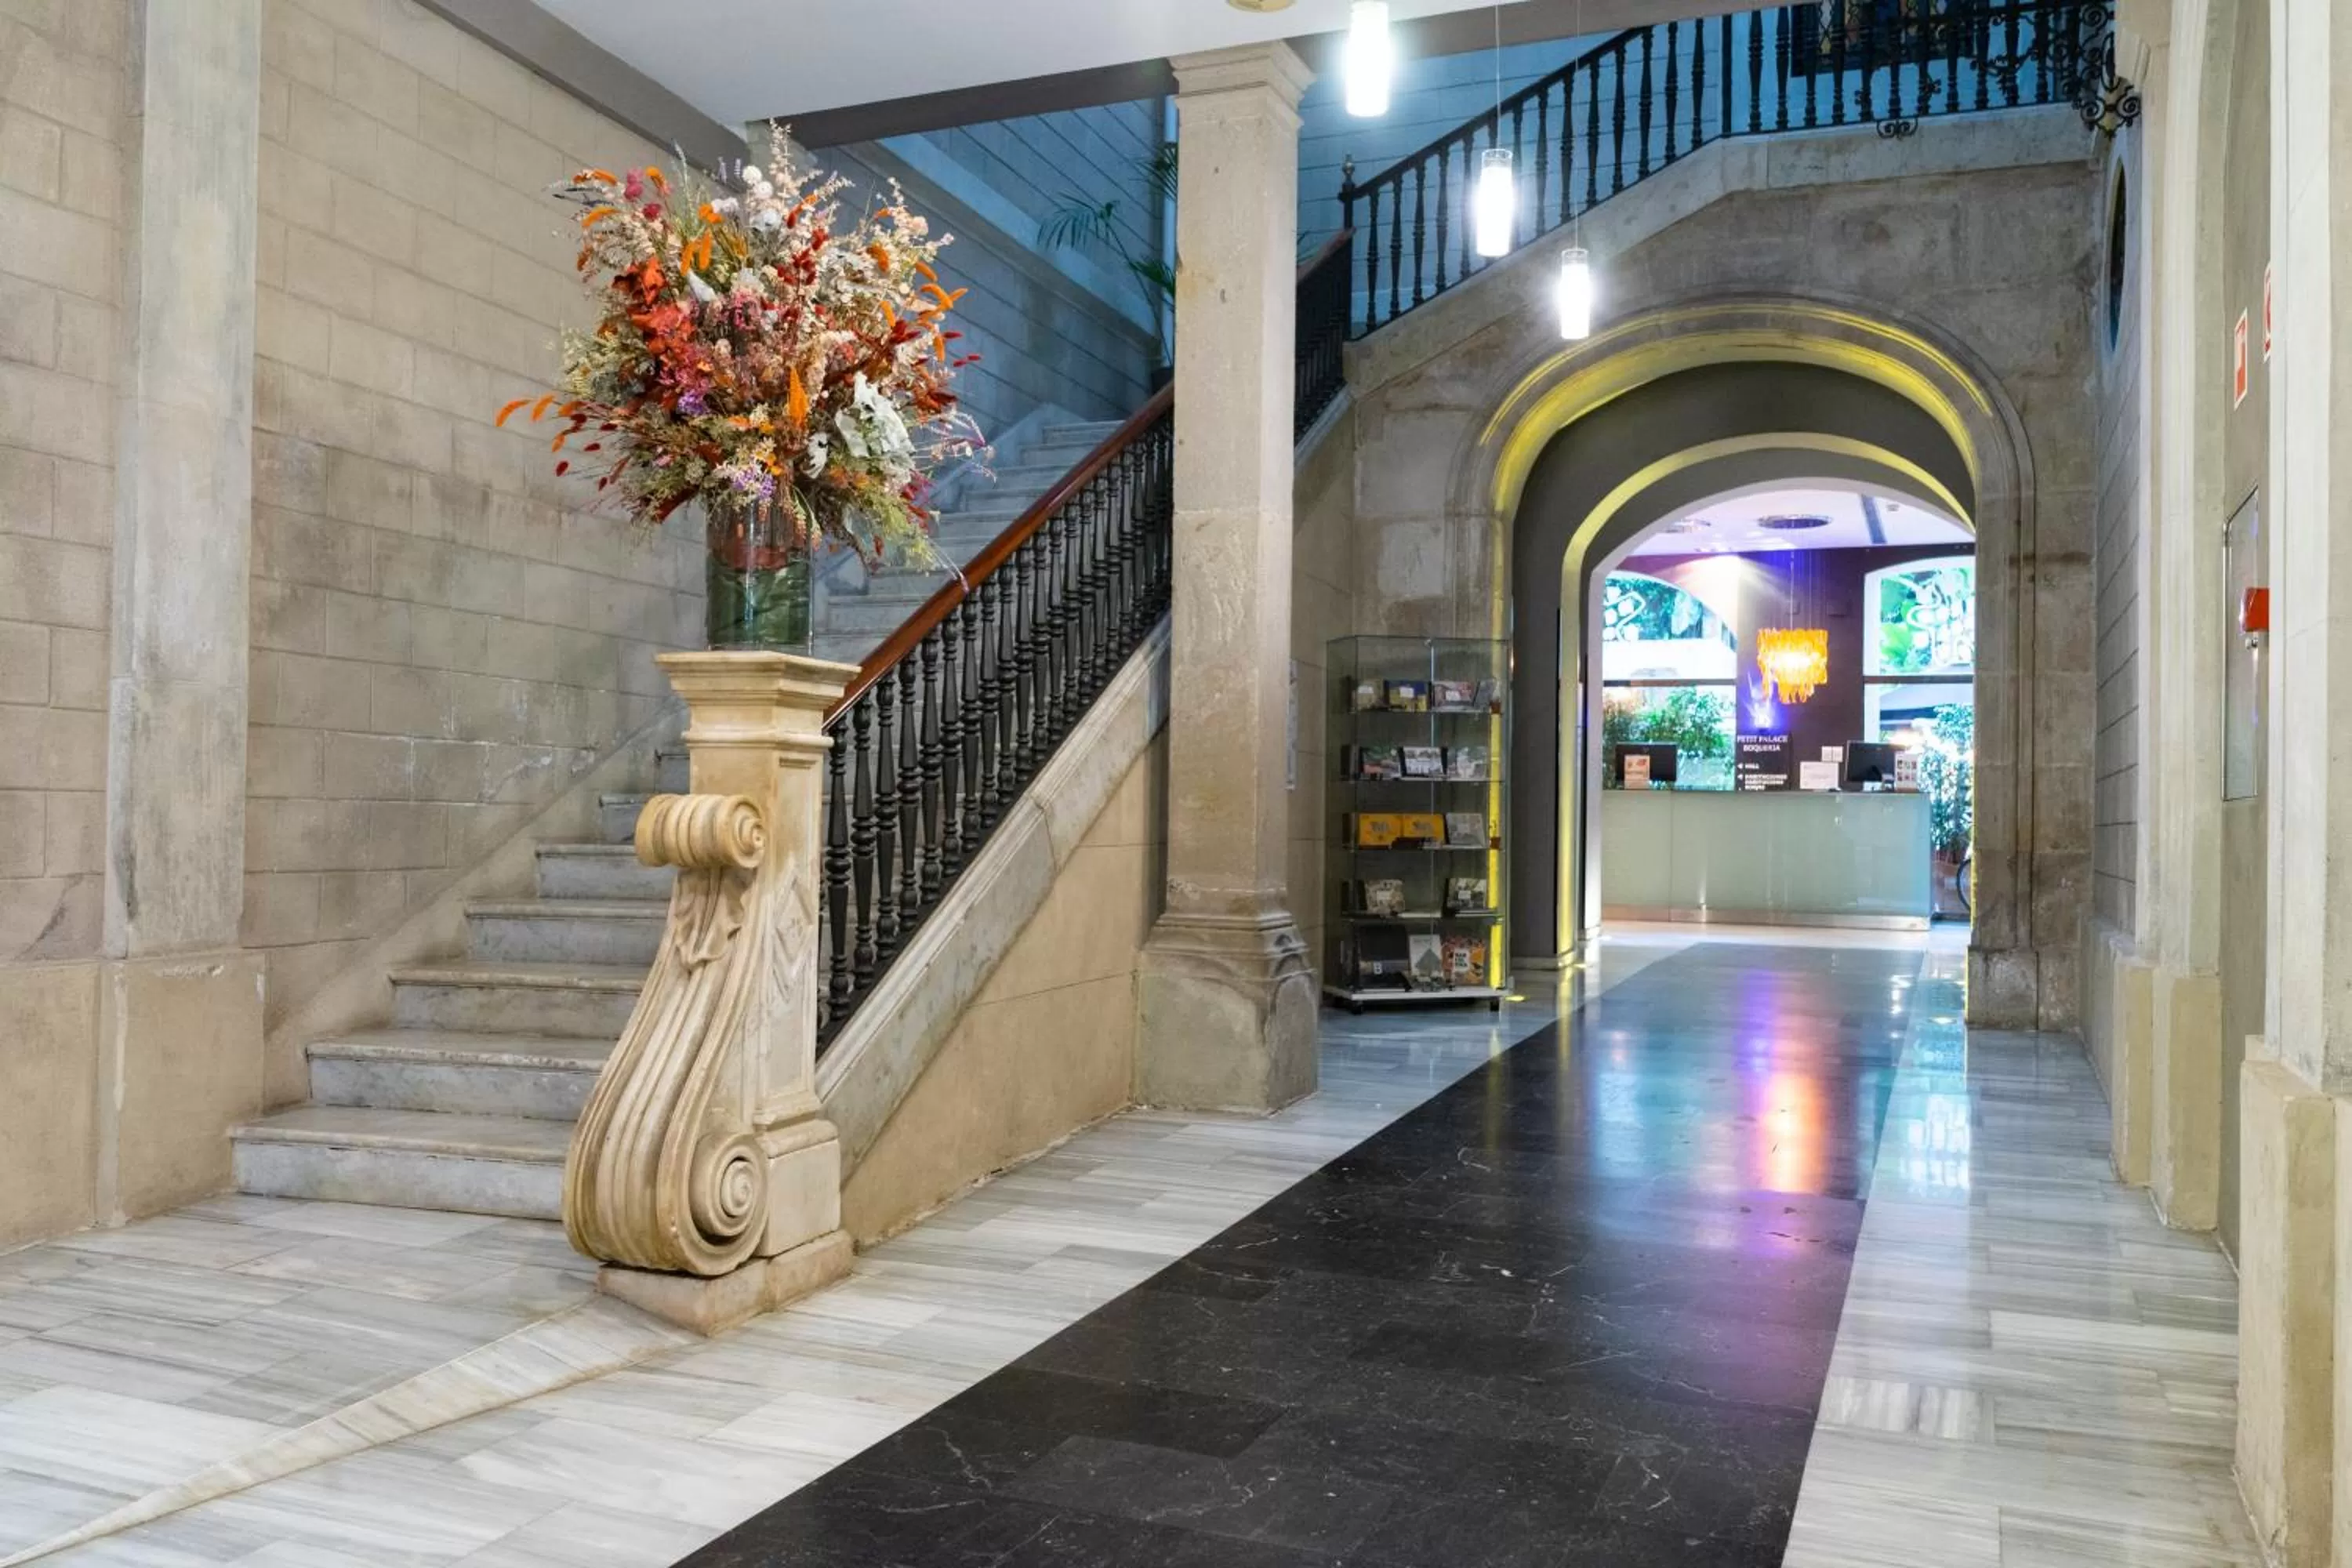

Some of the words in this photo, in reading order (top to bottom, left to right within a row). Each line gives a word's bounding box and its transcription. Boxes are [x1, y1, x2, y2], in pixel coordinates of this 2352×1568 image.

[1737, 735, 1757, 743] PETIT
[1759, 735, 1788, 743] PALACE
[1743, 744, 1780, 753] BOQUERIA
